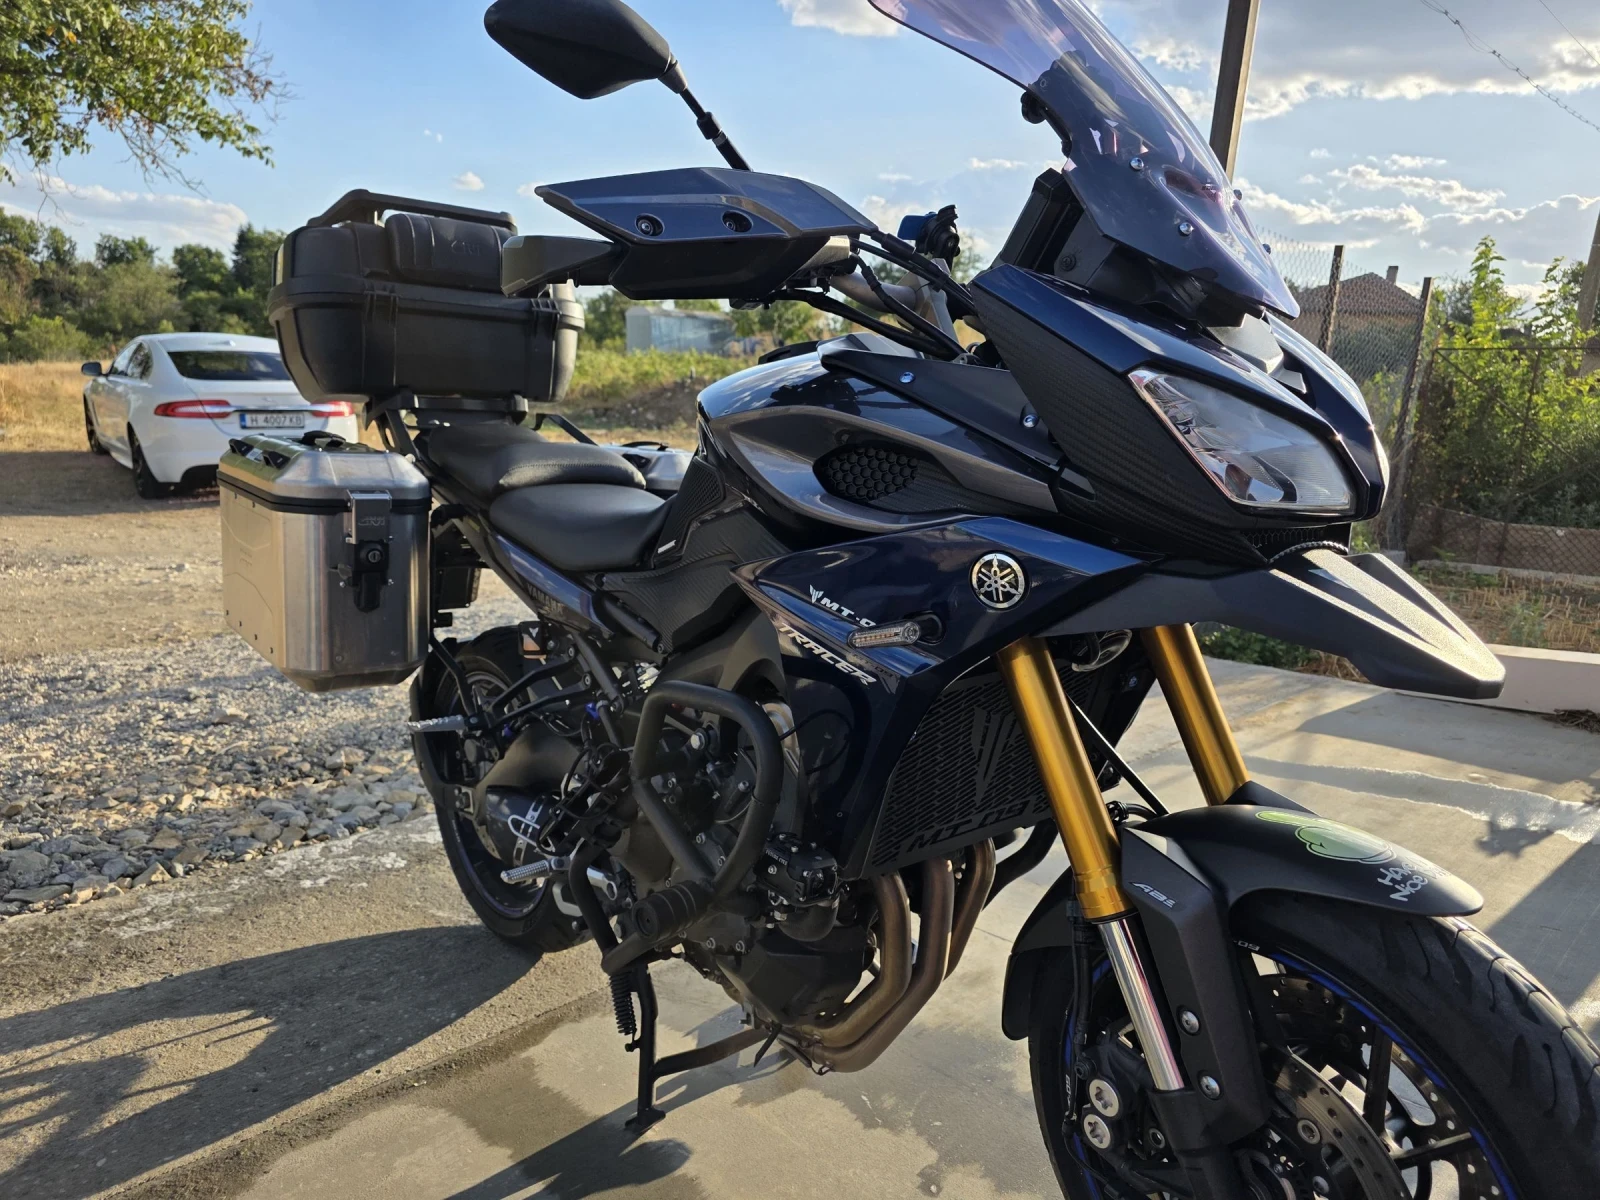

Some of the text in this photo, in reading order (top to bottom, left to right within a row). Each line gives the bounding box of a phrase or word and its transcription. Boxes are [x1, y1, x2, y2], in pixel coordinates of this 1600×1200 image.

[264, 416, 287, 426] 4007
[820, 597, 877, 628] MT-0
[779, 622, 877, 686] TRACER
[1131, 881, 1176, 908] ABS
